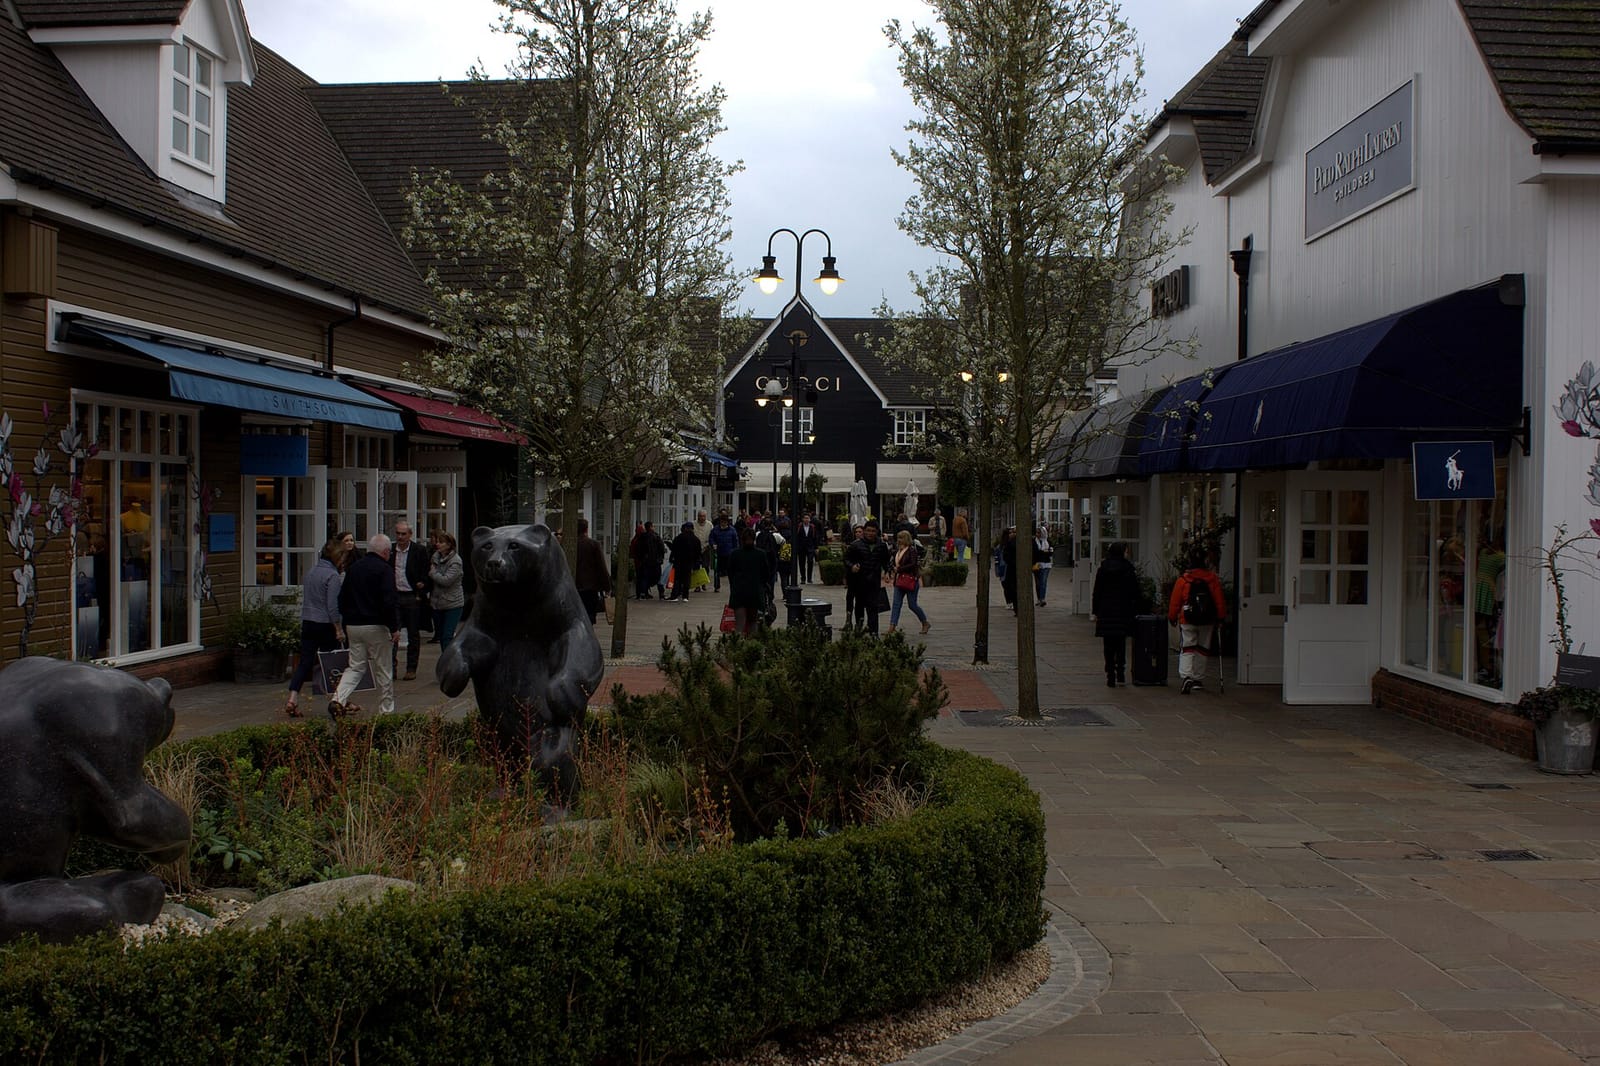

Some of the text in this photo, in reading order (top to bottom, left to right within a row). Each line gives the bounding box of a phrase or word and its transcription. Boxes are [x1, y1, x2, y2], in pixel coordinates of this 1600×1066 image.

[1336, 145, 1365, 181] RALPH
[1364, 121, 1402, 163] LAUREN
[1335, 169, 1376, 202] CHILDREN
[273, 395, 337, 417] SMYTHSON
